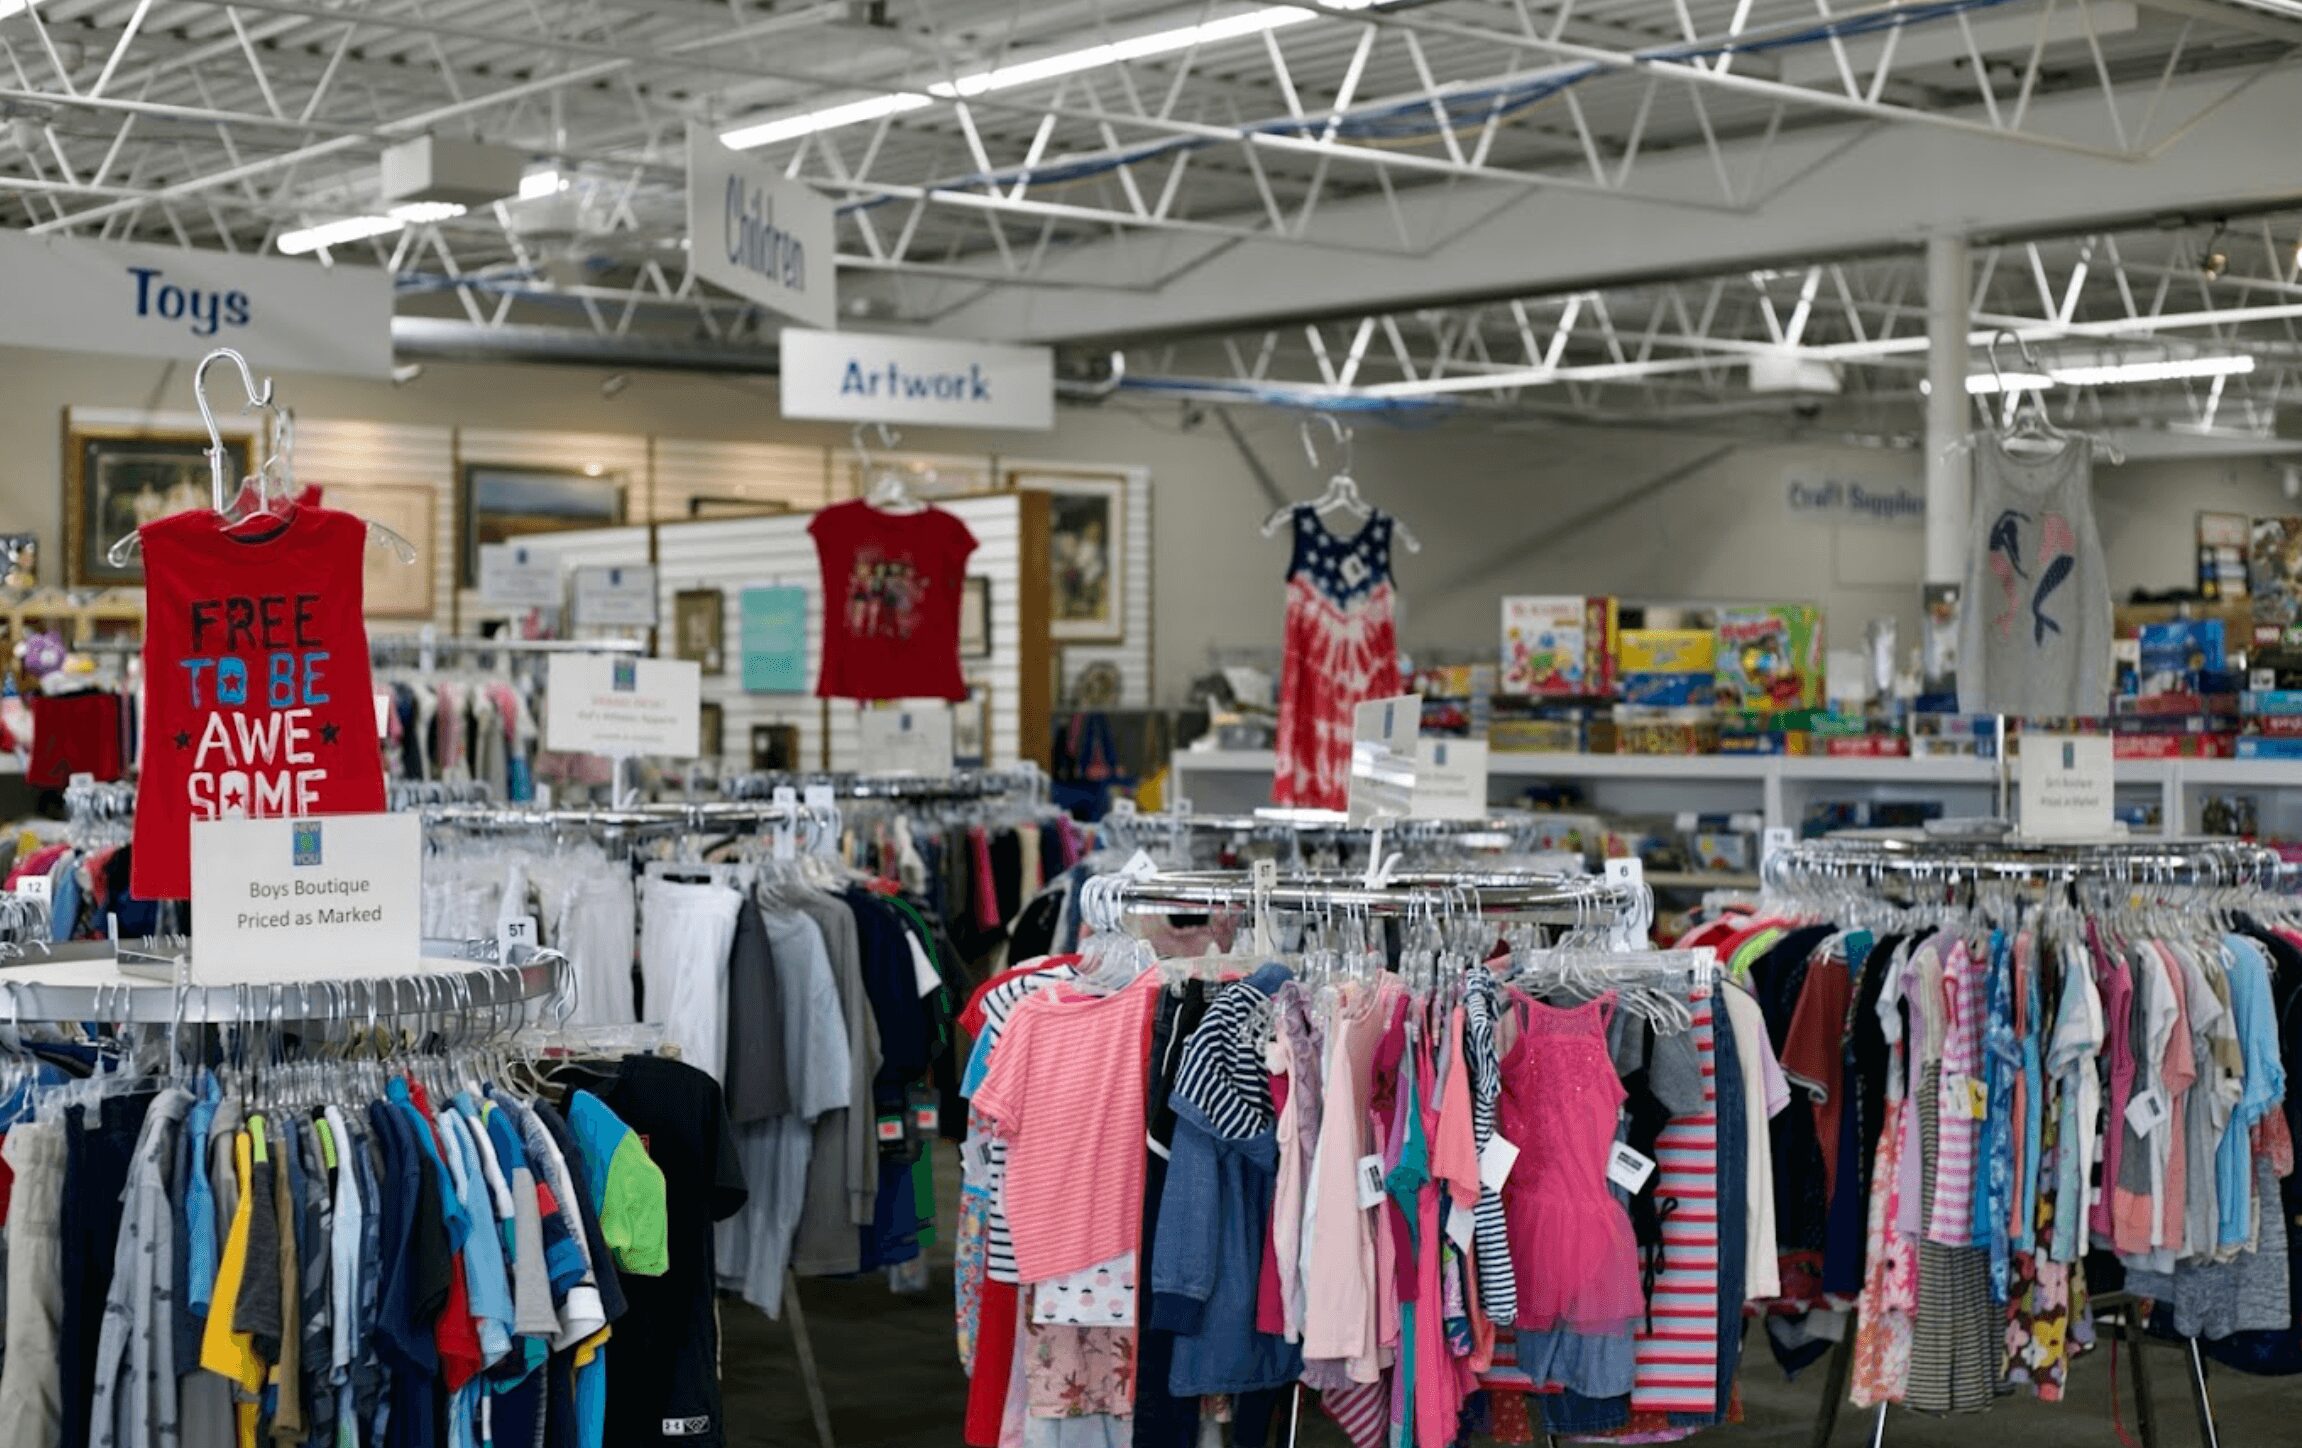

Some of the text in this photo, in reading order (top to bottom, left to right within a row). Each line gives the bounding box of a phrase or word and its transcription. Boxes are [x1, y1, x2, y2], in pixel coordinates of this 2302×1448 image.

[725, 173, 806, 293] Children
[126, 266, 250, 339] Toys
[841, 359, 992, 401] Artwork
[191, 594, 323, 652] FREE
[179, 651, 331, 710] TO BE
[193, 707, 316, 770] AWE
[28, 882, 42, 893] 12
[250, 878, 371, 899] Boys Boutique
[1620, 865, 1629, 877] 6
[237, 905, 383, 929] Priced as Marked
[509, 923, 526, 937] 5T
